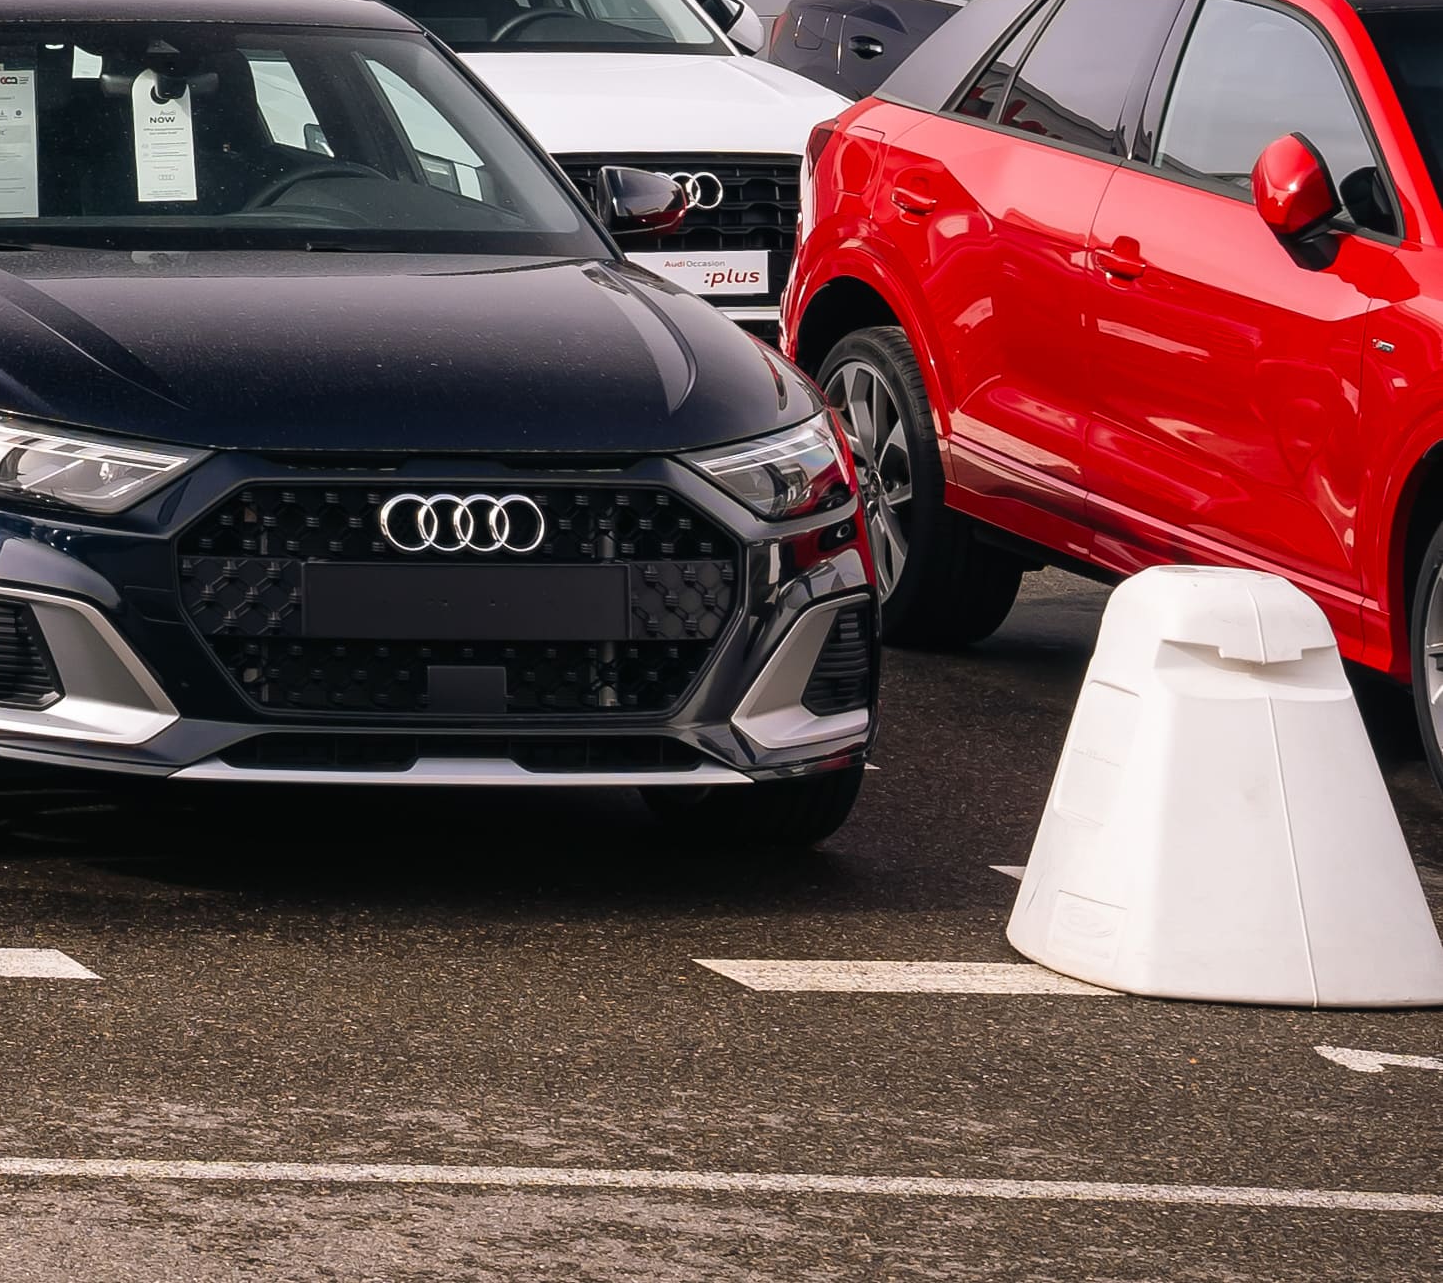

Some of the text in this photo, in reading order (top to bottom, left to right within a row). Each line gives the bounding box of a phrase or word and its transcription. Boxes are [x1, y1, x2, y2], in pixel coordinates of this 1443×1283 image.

[149, 116, 176, 124] NOW
[664, 259, 726, 268] Audi Occasion
[703, 268, 760, 288] :plus
